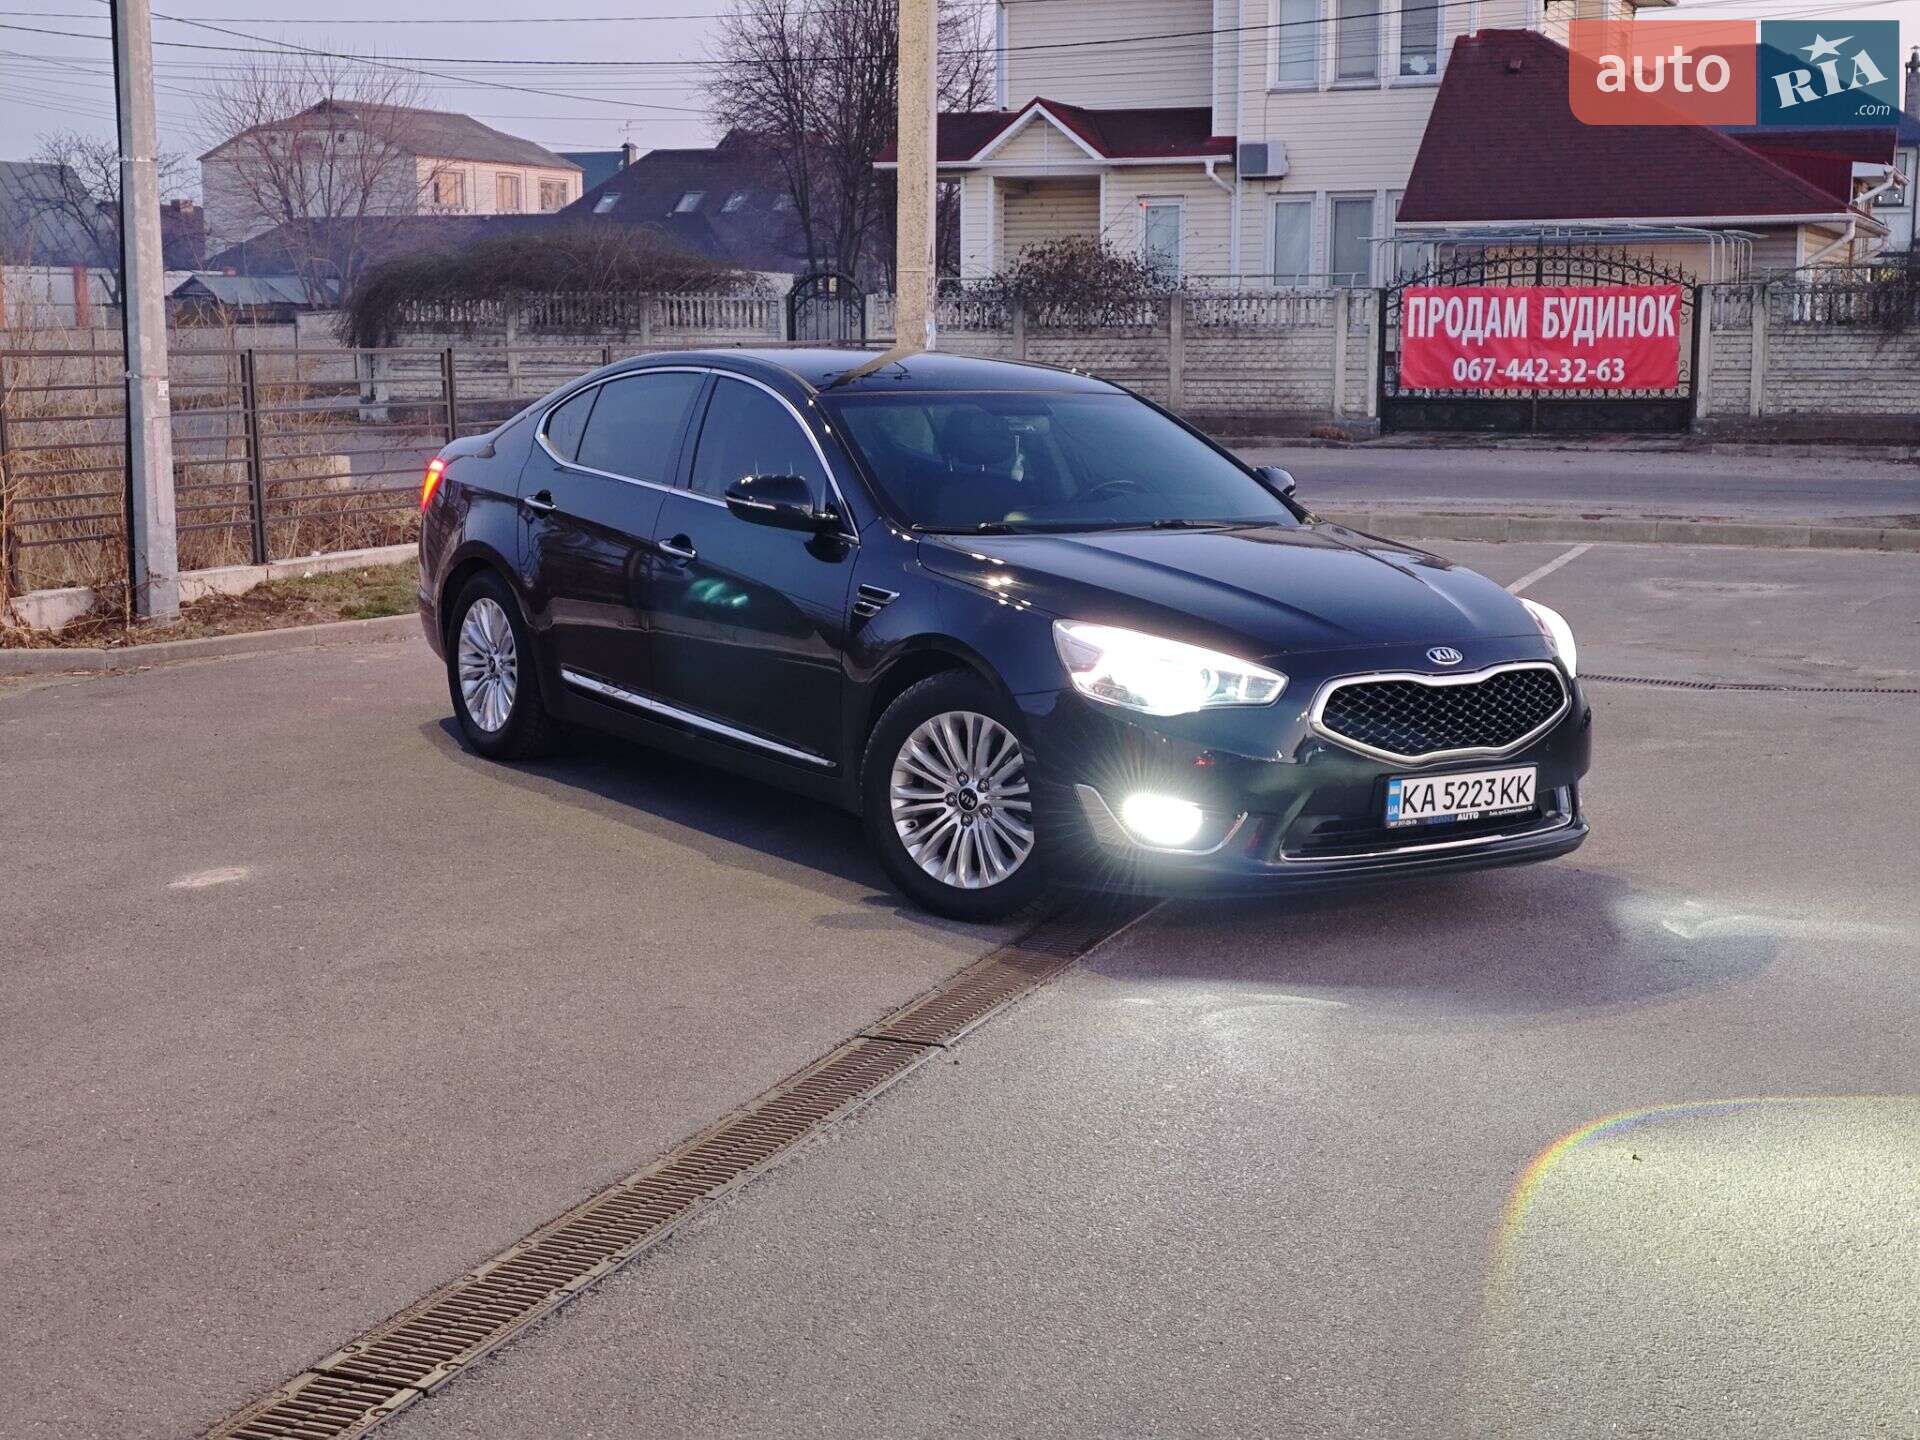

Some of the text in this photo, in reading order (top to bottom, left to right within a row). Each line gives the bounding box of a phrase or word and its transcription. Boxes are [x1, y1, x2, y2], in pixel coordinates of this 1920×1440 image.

[1407, 294, 1676, 347] ПРОДАМ БУДИНОК
[1453, 357, 1625, 383] 067-442-32-63
[1388, 805, 1399, 815] UA
[1457, 811, 1480, 822] AUTO
